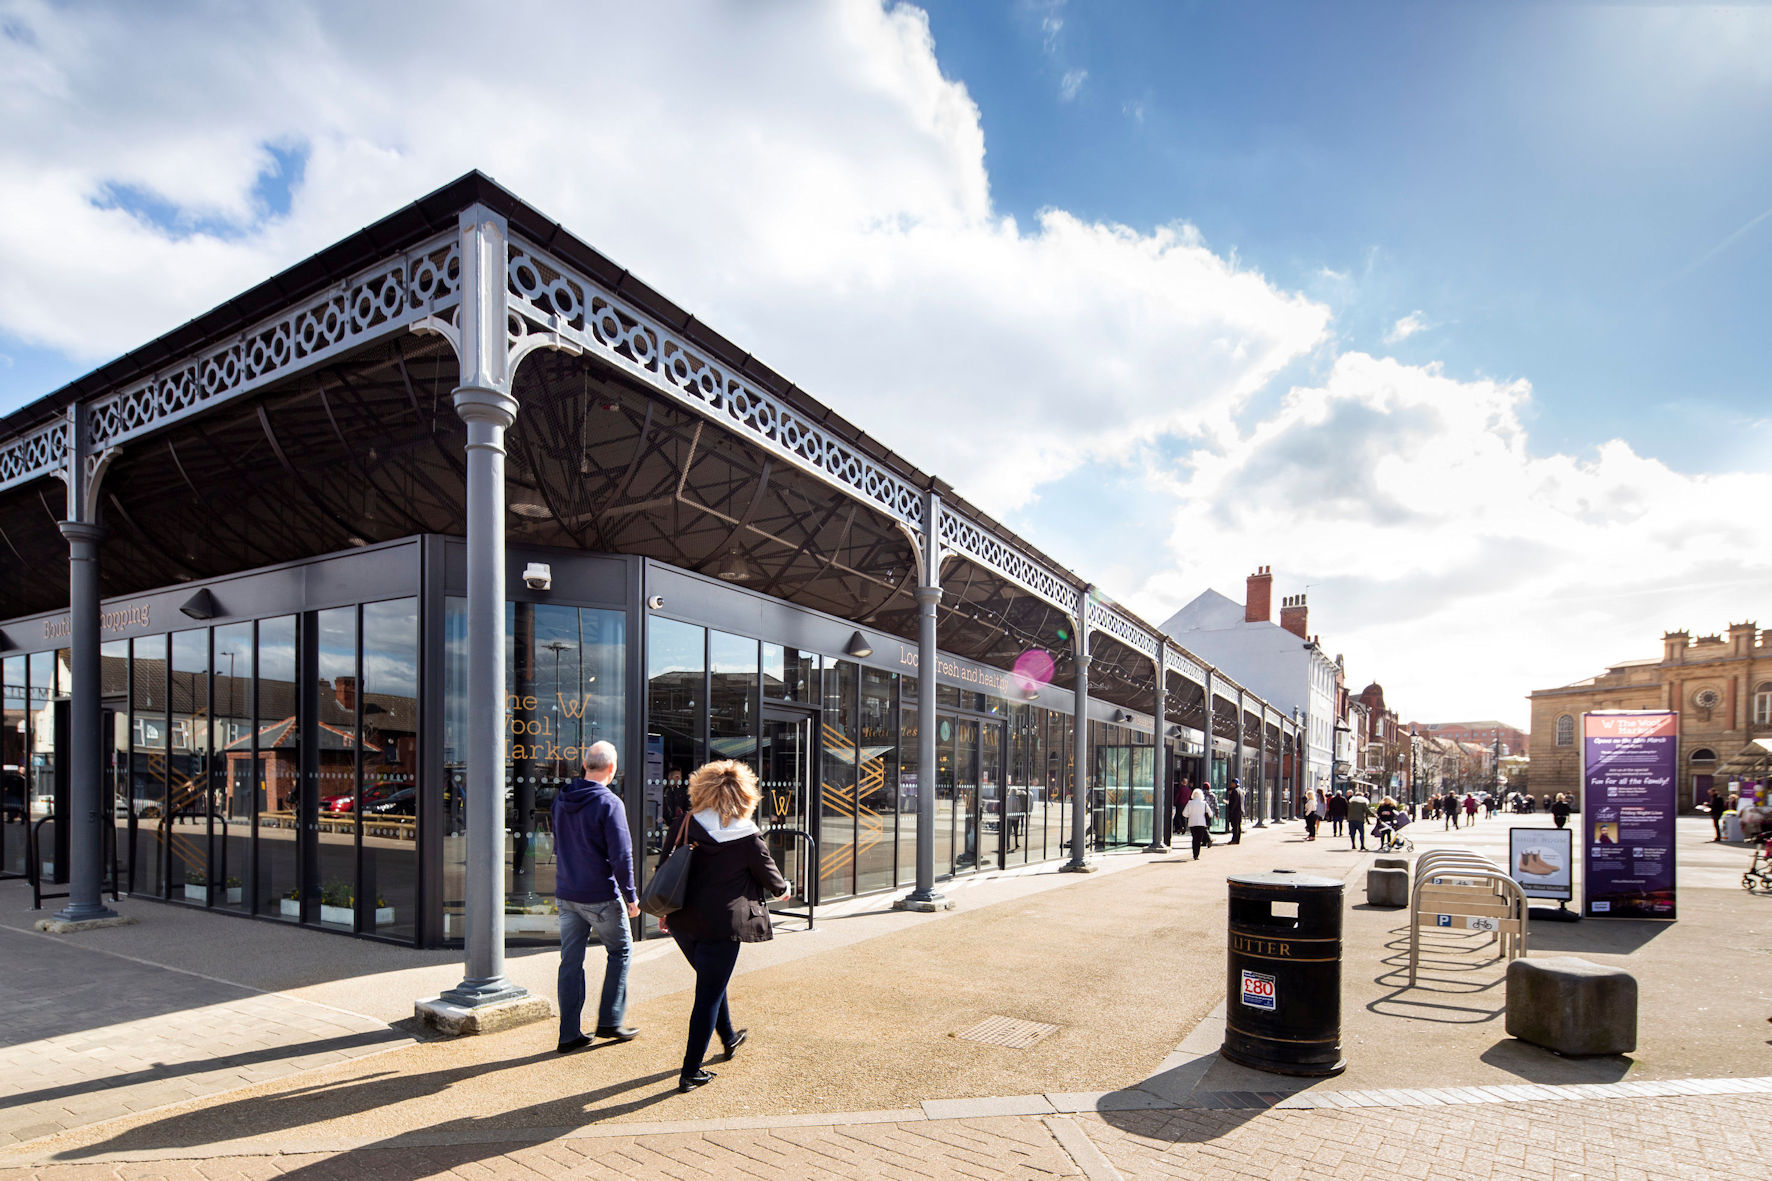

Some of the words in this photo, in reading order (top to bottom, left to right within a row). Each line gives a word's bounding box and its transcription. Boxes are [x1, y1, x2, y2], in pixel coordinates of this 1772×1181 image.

[43, 616, 71, 639] Bouti
[100, 603, 150, 632] hopping
[900, 645, 919, 667] Loc
[961, 667, 978, 682] and
[978, 668, 1009, 694] healthy
[505, 689, 538, 711] he
[505, 714, 552, 736] ool
[505, 739, 592, 761] arket
[1618, 777, 1628, 785] all
[1629, 777, 1642, 785] the
[771, 789, 793, 816] W
[1440, 915, 1450, 926] P
[1233, 935, 1291, 957] LITTER
[1244, 978, 1274, 996] £80
